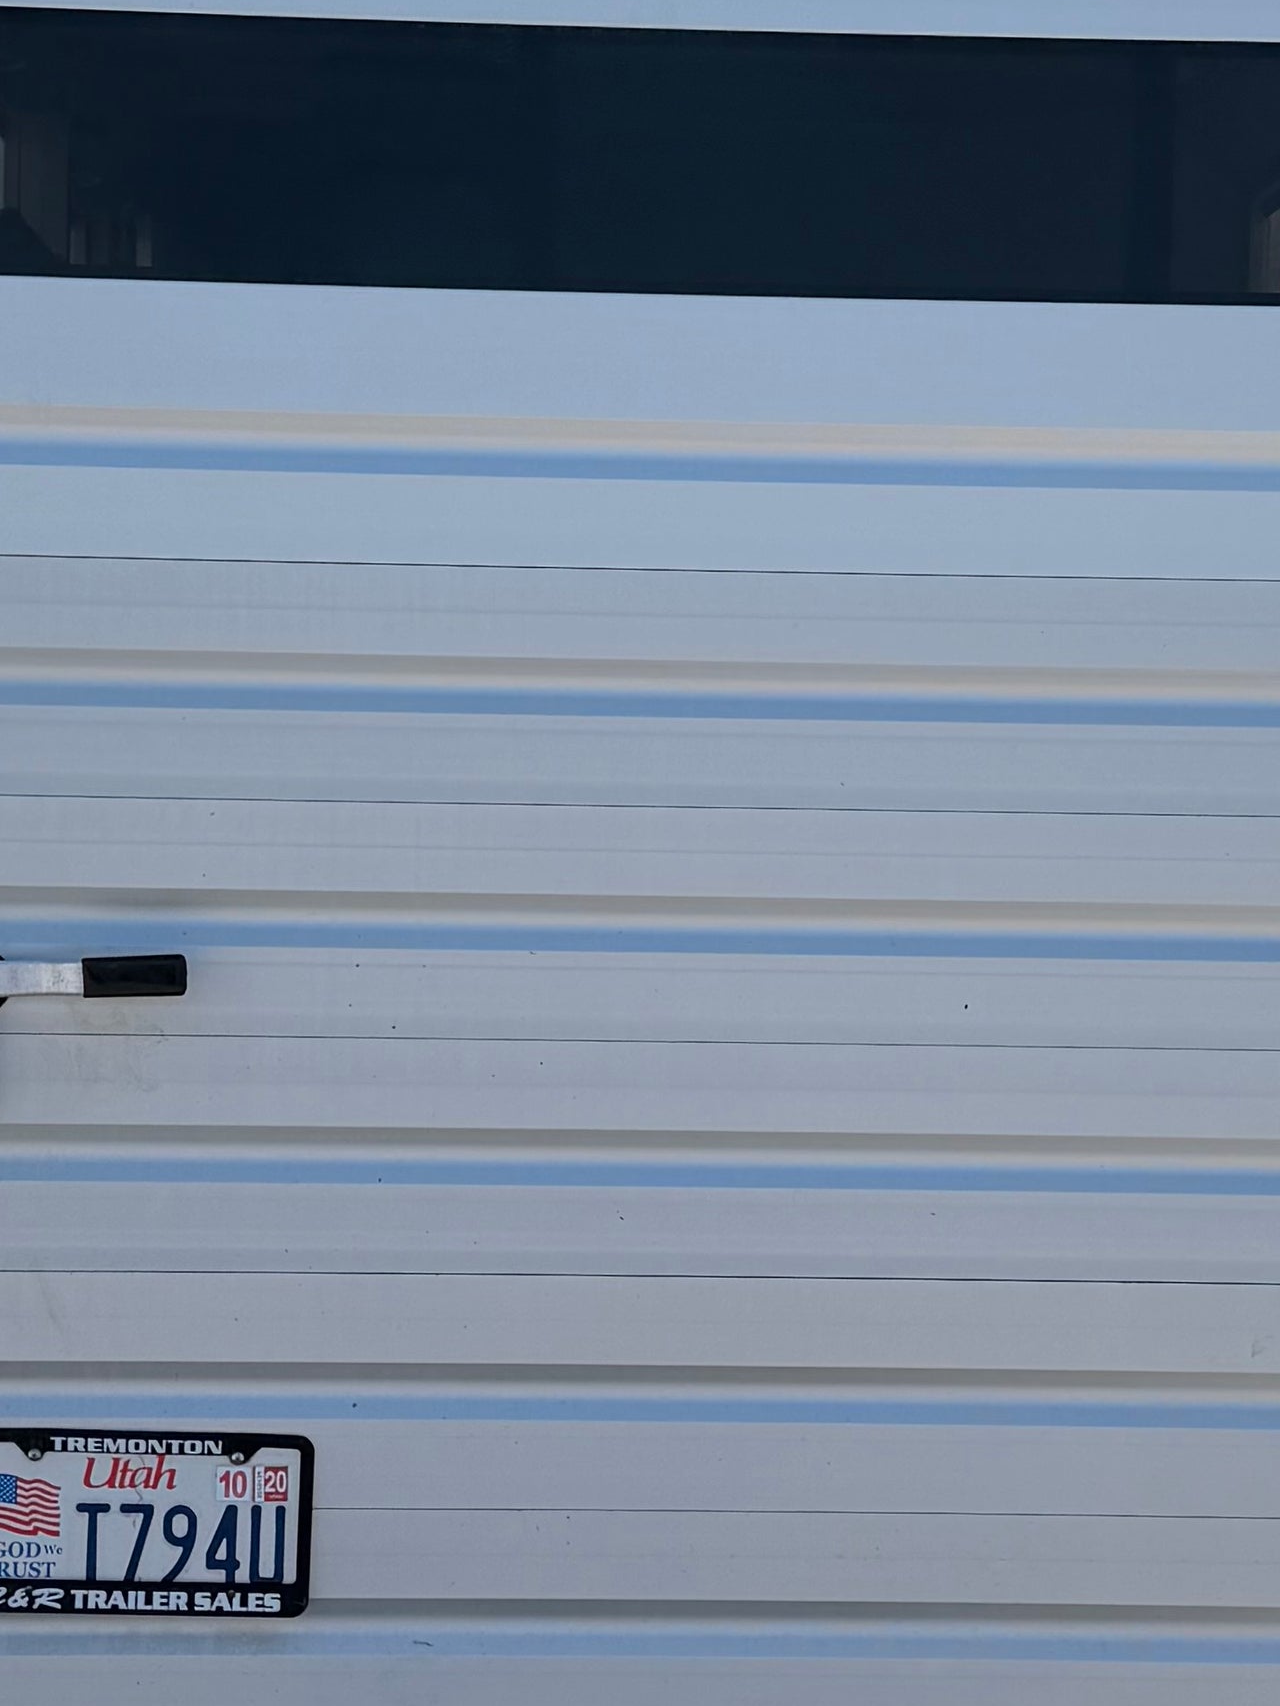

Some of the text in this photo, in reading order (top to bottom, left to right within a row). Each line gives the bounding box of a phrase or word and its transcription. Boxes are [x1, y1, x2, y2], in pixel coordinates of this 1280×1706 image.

[49, 1436, 223, 1456] TREMONTON
[82, 1454, 177, 1491] Utah
[219, 1470, 248, 1499] 10
[265, 1470, 287, 1494] 20
[43, 1544, 63, 1556] We
[75, 1503, 286, 1584] T794U
[70, 1589, 188, 1612] TRAILER
[193, 1591, 282, 1614] SALES
